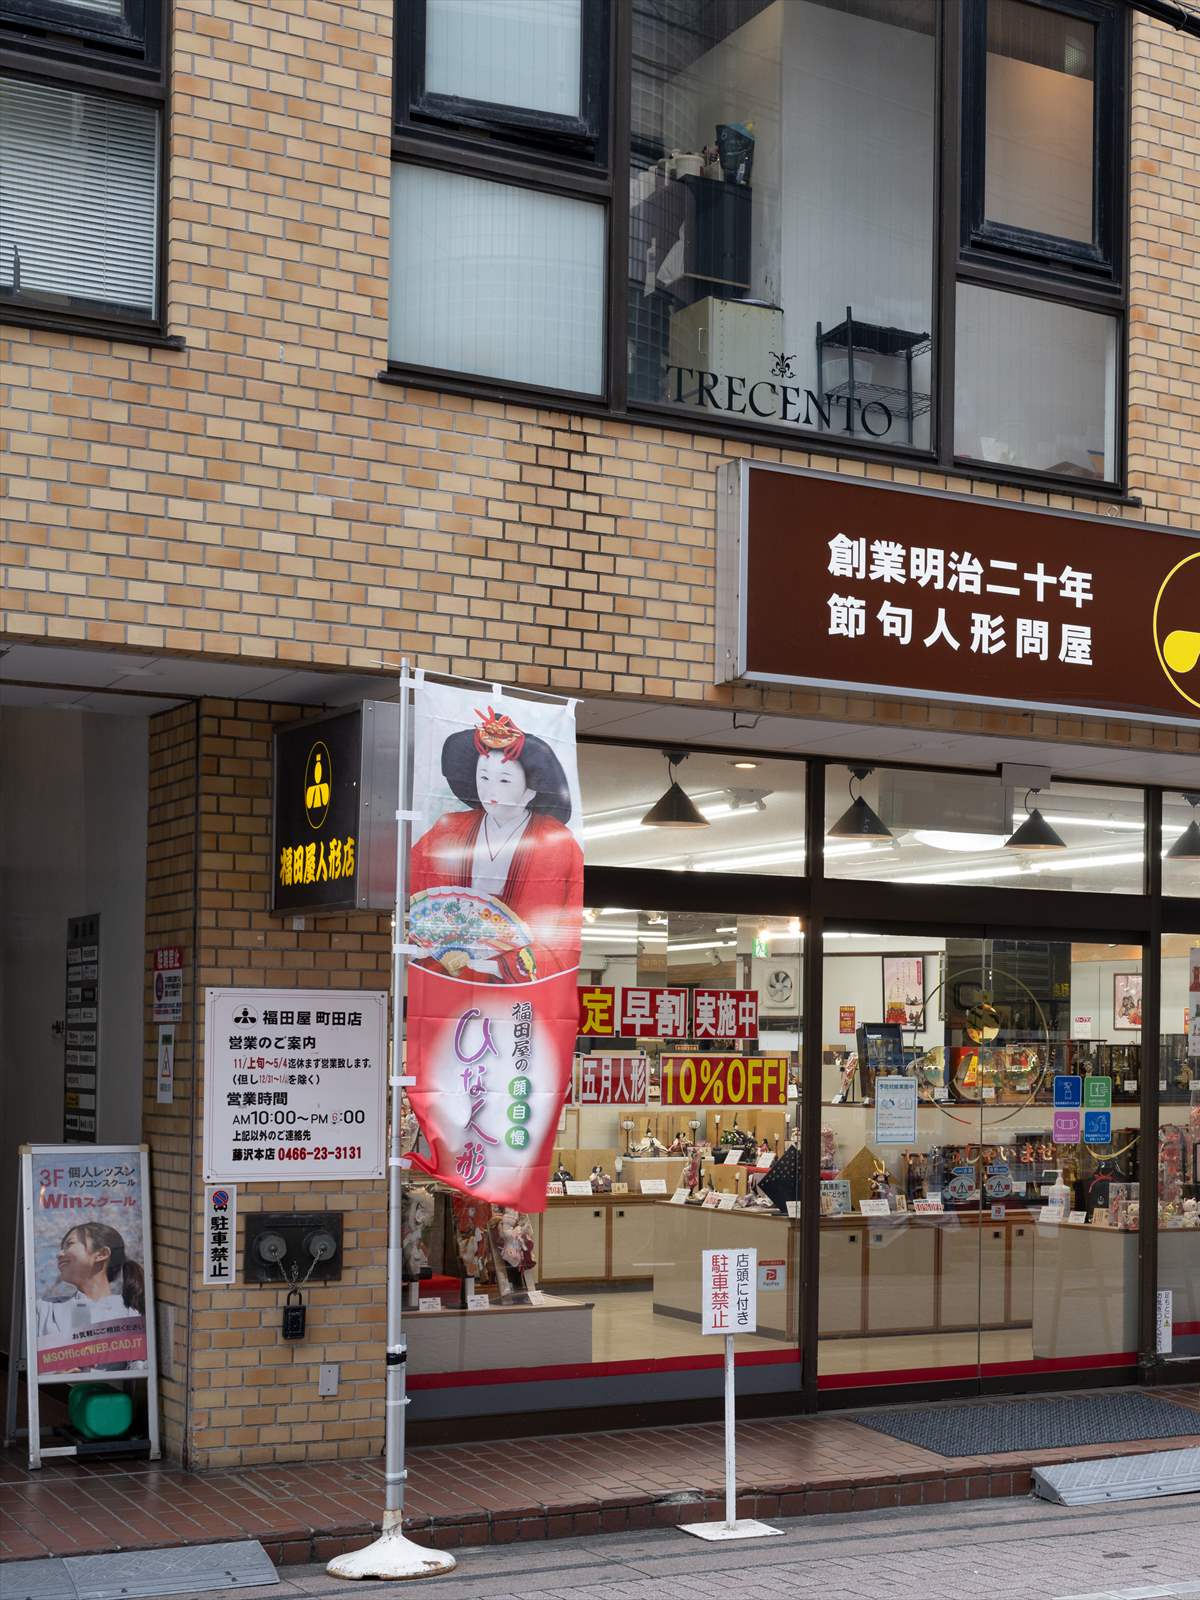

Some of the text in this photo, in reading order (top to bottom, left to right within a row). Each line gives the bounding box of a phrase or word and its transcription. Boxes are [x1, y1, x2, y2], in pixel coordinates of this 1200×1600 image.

[666, 365, 892, 437] TRECENTO
[827, 533, 1093, 608] 創業明治二十年
[827, 593, 1093, 666] 節句人形問屋
[280, 836, 356, 887] 福田屋人形店
[262, 1010, 362, 1027] 福田屋 町田店
[511, 1002, 532, 1072] 福田屋の
[622, 990, 686, 1036] 早割
[696, 992, 757, 1037] 実施中
[228, 1035, 316, 1050] 営業のご案内
[227, 1091, 288, 1106] 営業時間
[583, 1058, 788, 1105] 五月人形 10%OFF!
[232, 1130, 312, 1142] 上記以外のご連絡先
[232, 1146, 362, 1161] 藤沢本店 0466-23-3131
[39, 1168, 64, 1187] 3F
[68, 1166, 136, 1179] 個人レッスン
[68, 1179, 136, 1189] パソコンスクール
[42, 1193, 137, 1209] Winスクール
[210, 1215, 229, 1278] 駐車禁止
[711, 1254, 729, 1329] 駐車禁止
[736, 1253, 750, 1326] 店頭に付き
